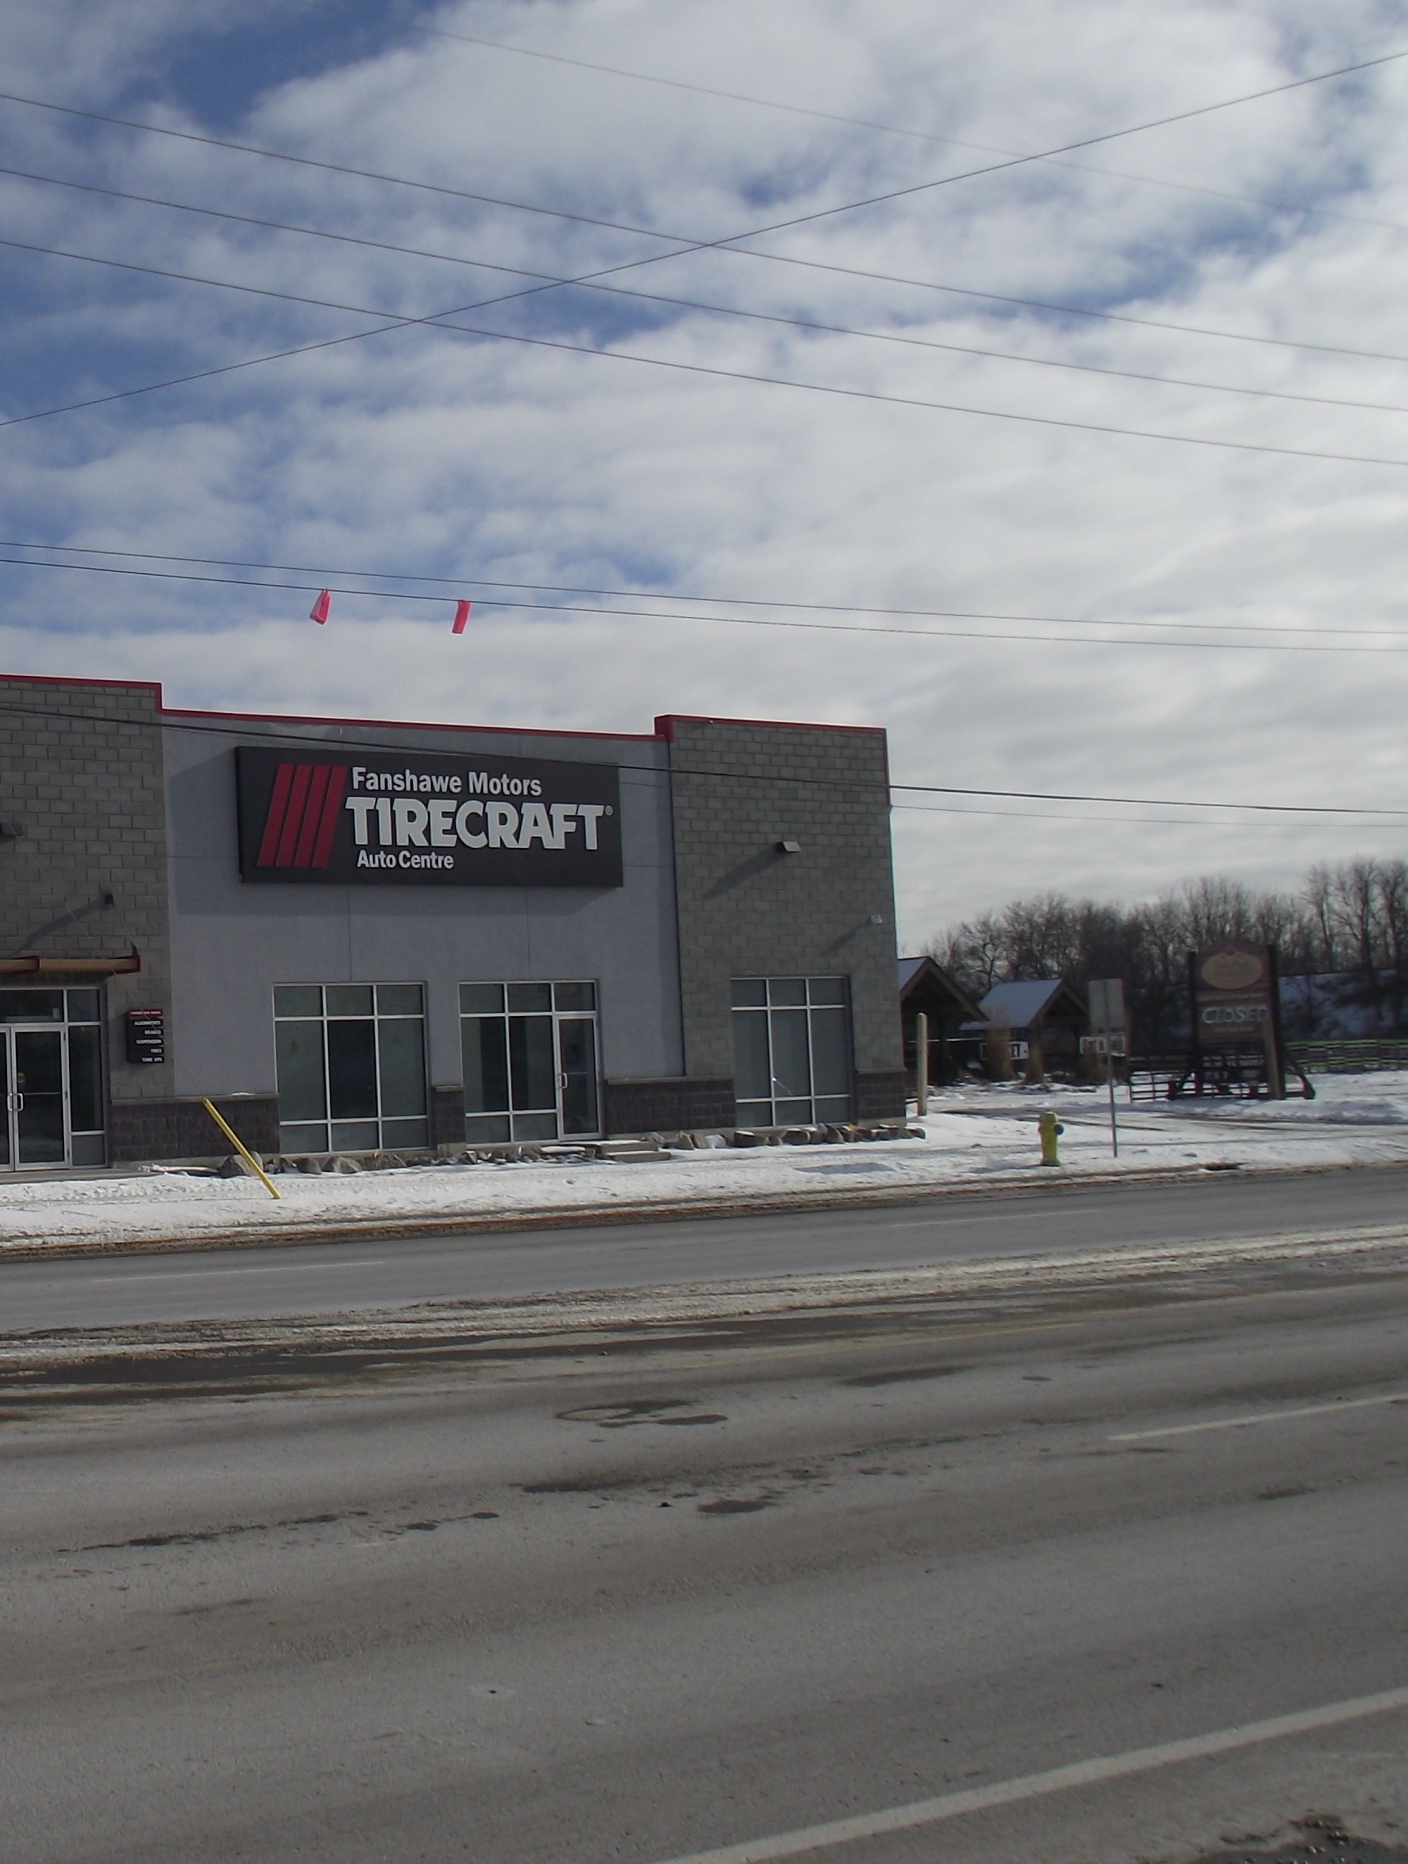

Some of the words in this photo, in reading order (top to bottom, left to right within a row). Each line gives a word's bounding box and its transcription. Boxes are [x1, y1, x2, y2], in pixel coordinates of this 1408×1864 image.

[352, 766, 462, 793] Fanshawe
[468, 771, 542, 796] Motors
[345, 796, 604, 850] TIRECRAFT
[357, 850, 396, 868] Auto
[398, 850, 454, 869] Centre
[1202, 1004, 1268, 1024] CLOSED
